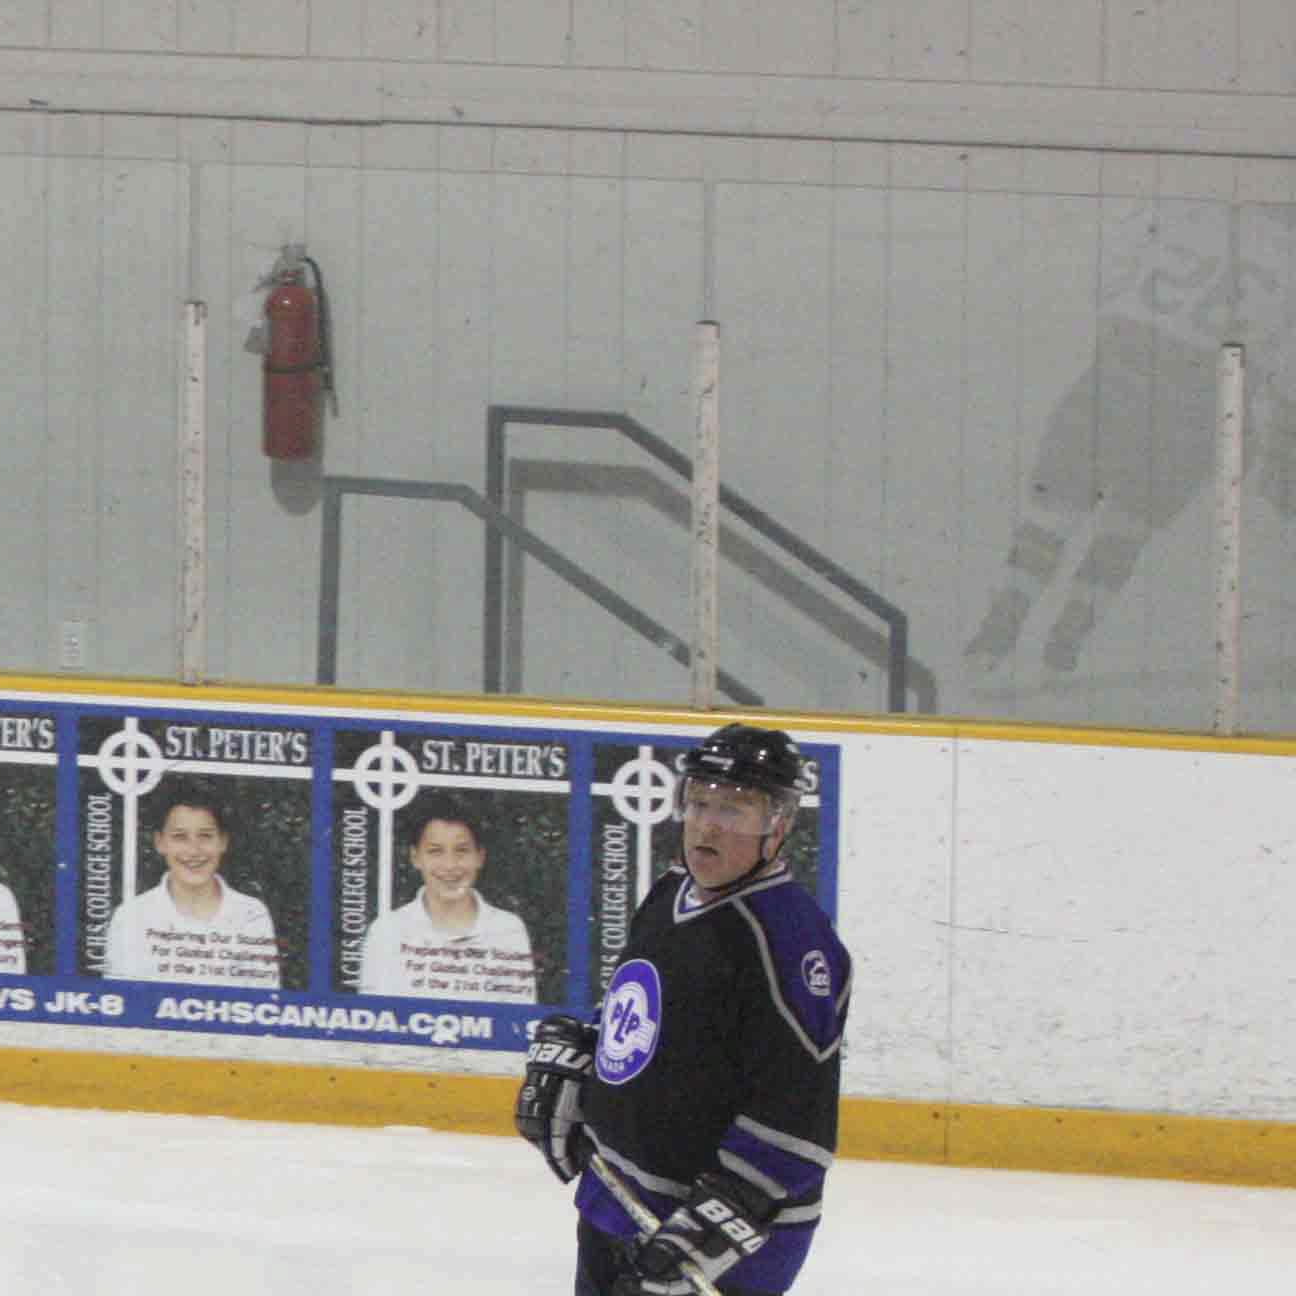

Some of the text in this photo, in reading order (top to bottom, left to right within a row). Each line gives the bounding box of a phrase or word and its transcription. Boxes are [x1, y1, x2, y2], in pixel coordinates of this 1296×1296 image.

[165, 726, 308, 763] ST. PETER'S
[422, 740, 566, 777] ST. PETER'S
[87, 792, 112, 851] SCHOOL
[342, 806, 368, 866] SCHOOL
[602, 823, 628, 881] SCHOOL
[87, 854, 111, 918] COLLEGE
[342, 868, 367, 933] COLLEGE
[601, 884, 626, 948] COLLEGE
[44, 990, 125, 1016] JK-8
[156, 997, 493, 1039] ACHSCANADA.COM
